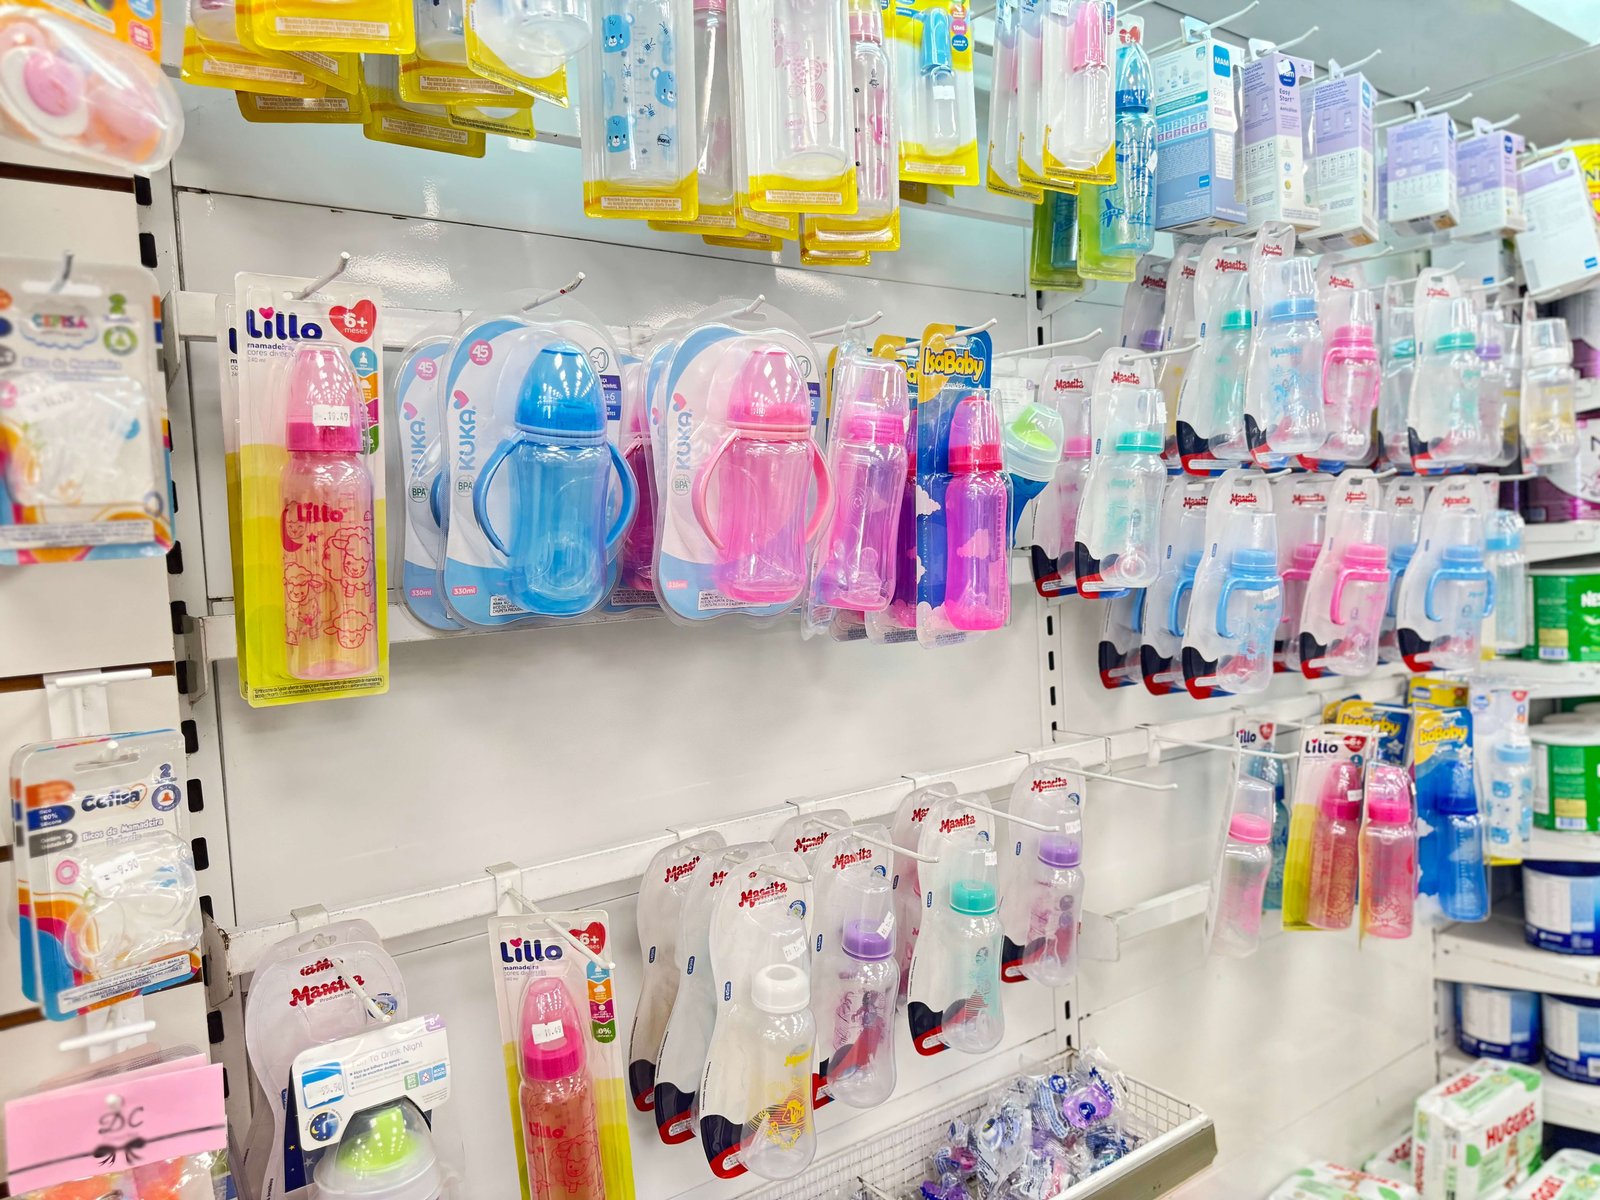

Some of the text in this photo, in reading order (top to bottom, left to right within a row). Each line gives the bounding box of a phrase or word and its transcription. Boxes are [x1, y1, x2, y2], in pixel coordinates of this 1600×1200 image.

[1214, 56, 1229, 66] MAM
[1280, 88, 1291, 97] Easy
[1215, 258, 1248, 272] Mamita
[246, 307, 323, 340] Lillo
[343, 312, 368, 328] 6+
[344, 327, 368, 335] meses
[472, 345, 489, 358] 45
[418, 361, 434, 374] 45
[923, 347, 985, 382] IsaBaby
[1053, 378, 1084, 391] Mamita
[1111, 371, 1140, 384] Mamita
[459, 409, 477, 471] KUKA
[676, 411, 693, 470] KUKA
[411, 488, 426, 496] BPA
[458, 482, 473, 490] BPA
[297, 502, 344, 523] Lillo
[454, 588, 476, 596] 330ml
[1305, 738, 1339, 754] Lillo
[159, 763, 171, 779] 2
[1031, 776, 1068, 793] Mamita
[81, 789, 141, 812] Cefisa
[82, 817, 164, 842] Bicos de Mamadeira
[939, 813, 976, 834] Mamita
[65, 833, 74, 845] 2
[739, 881, 787, 908] Mamita
[580, 933, 600, 945] 6+
[500, 937, 563, 963] Lillo
[503, 964, 539, 972] mamadeira
[370, 1054, 379, 1063] To
[381, 1047, 401, 1060] Drink
[402, 1040, 424, 1053] Night
[528, 1120, 565, 1139] Lillo
[1486, 1101, 1536, 1150] HUGGIES
